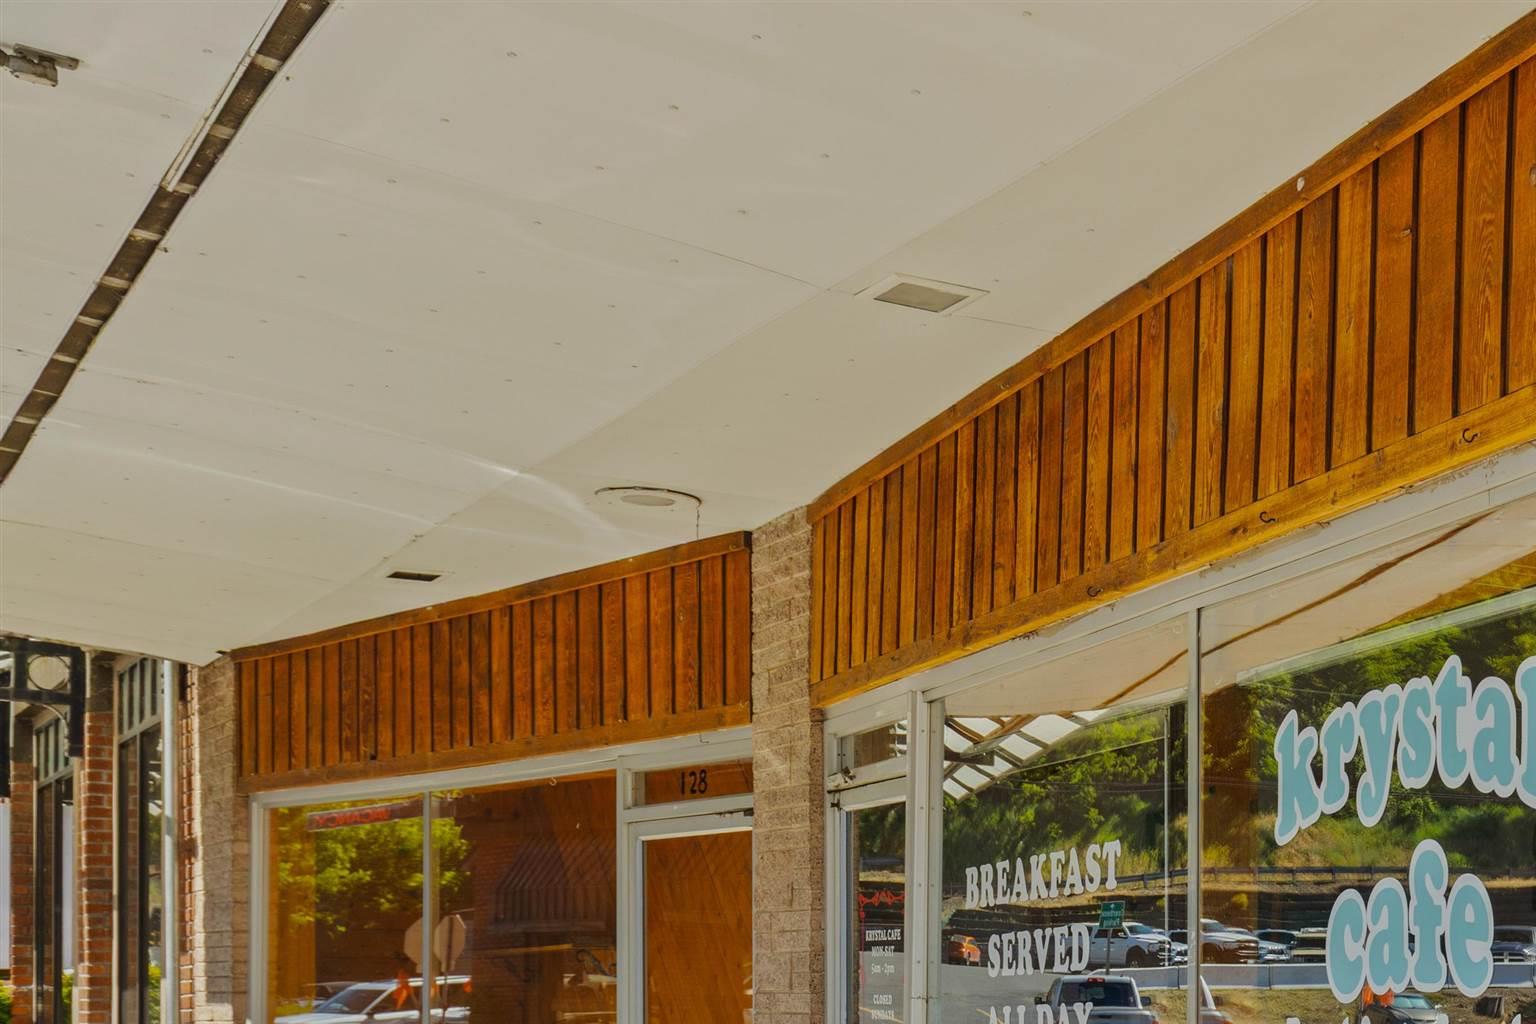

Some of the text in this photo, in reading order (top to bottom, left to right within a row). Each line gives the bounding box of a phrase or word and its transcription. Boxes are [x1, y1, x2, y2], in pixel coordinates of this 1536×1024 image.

[680, 768, 708, 795] 128
[964, 840, 1122, 910] BREAKFAST
[865, 928, 901, 942] KRYSTAL CAFE
[1325, 838, 1495, 1004] cafe
[987, 922, 1090, 979] SERVED
